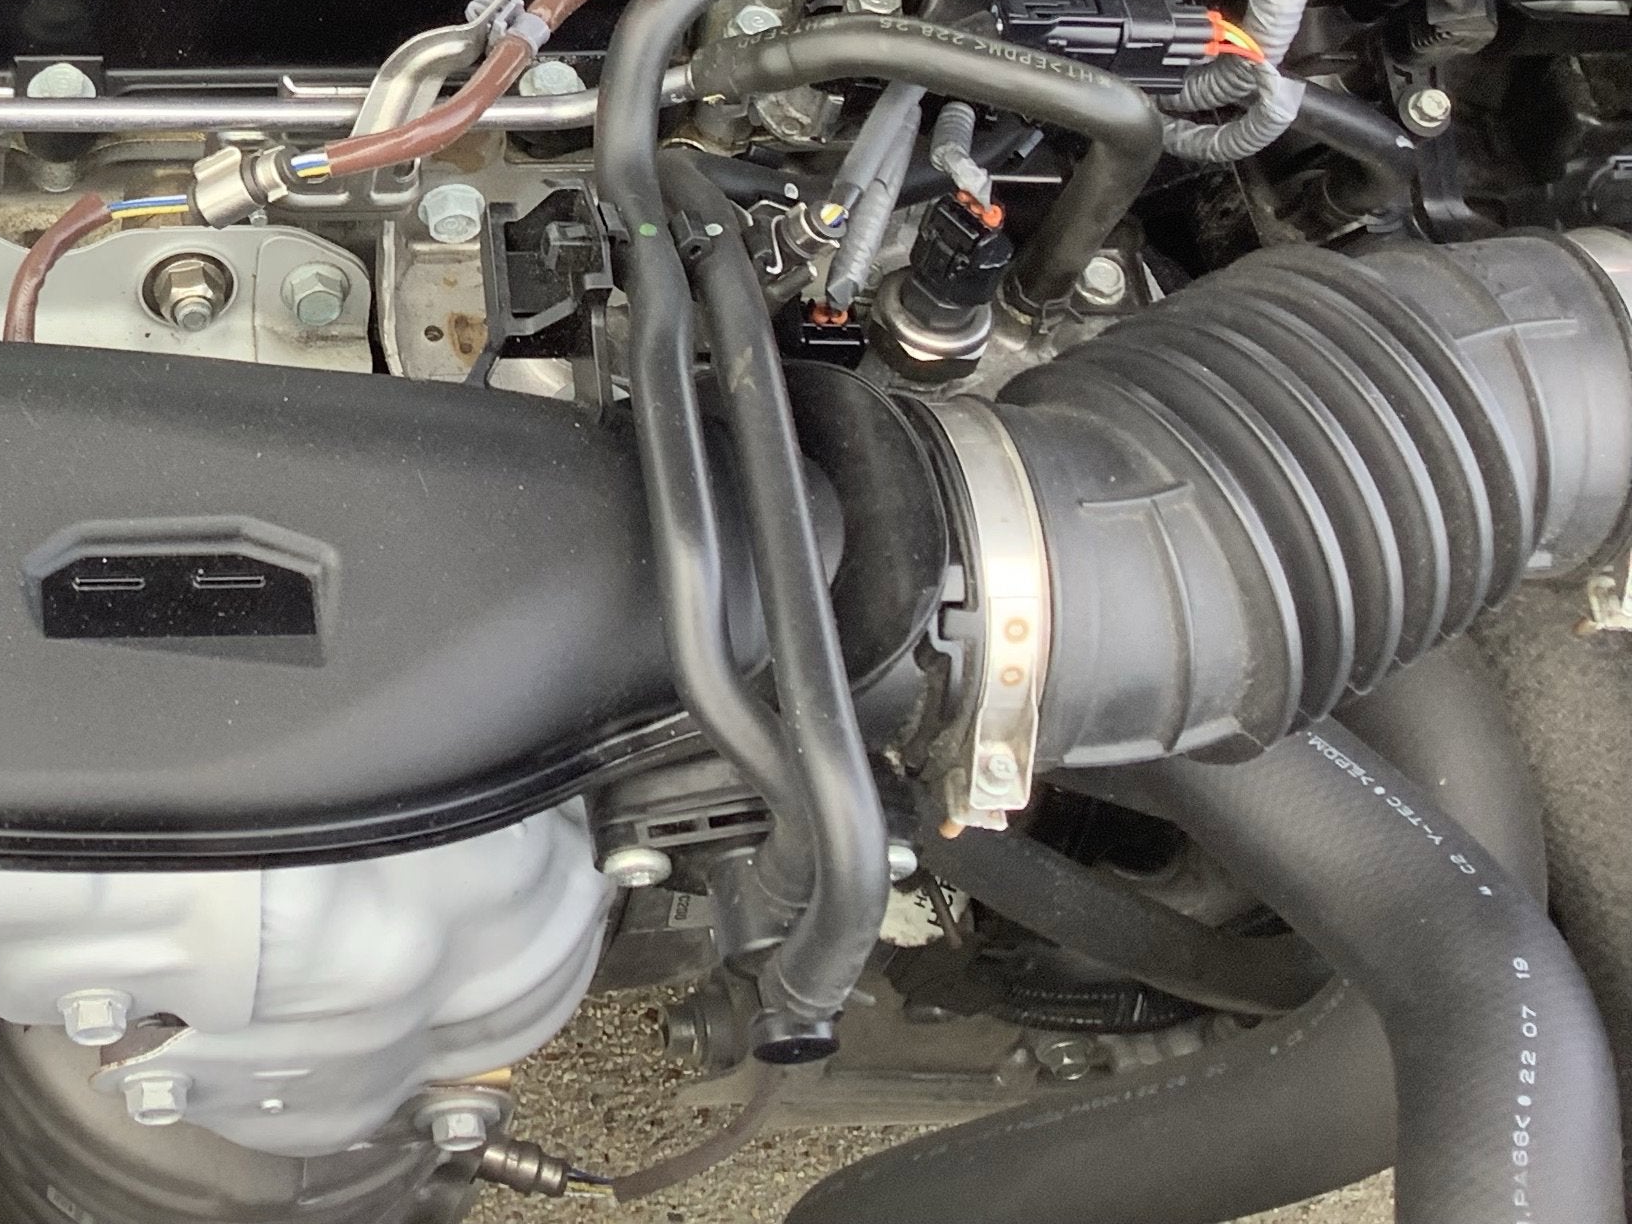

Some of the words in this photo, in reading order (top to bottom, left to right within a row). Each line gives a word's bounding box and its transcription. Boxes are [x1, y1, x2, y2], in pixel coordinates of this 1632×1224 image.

[1386, 796, 1444, 846] Y-TEC
[1513, 956, 1531, 979] 19
[1522, 1005, 1538, 1038] 07
[1520, 1049, 1537, 1084] 22
